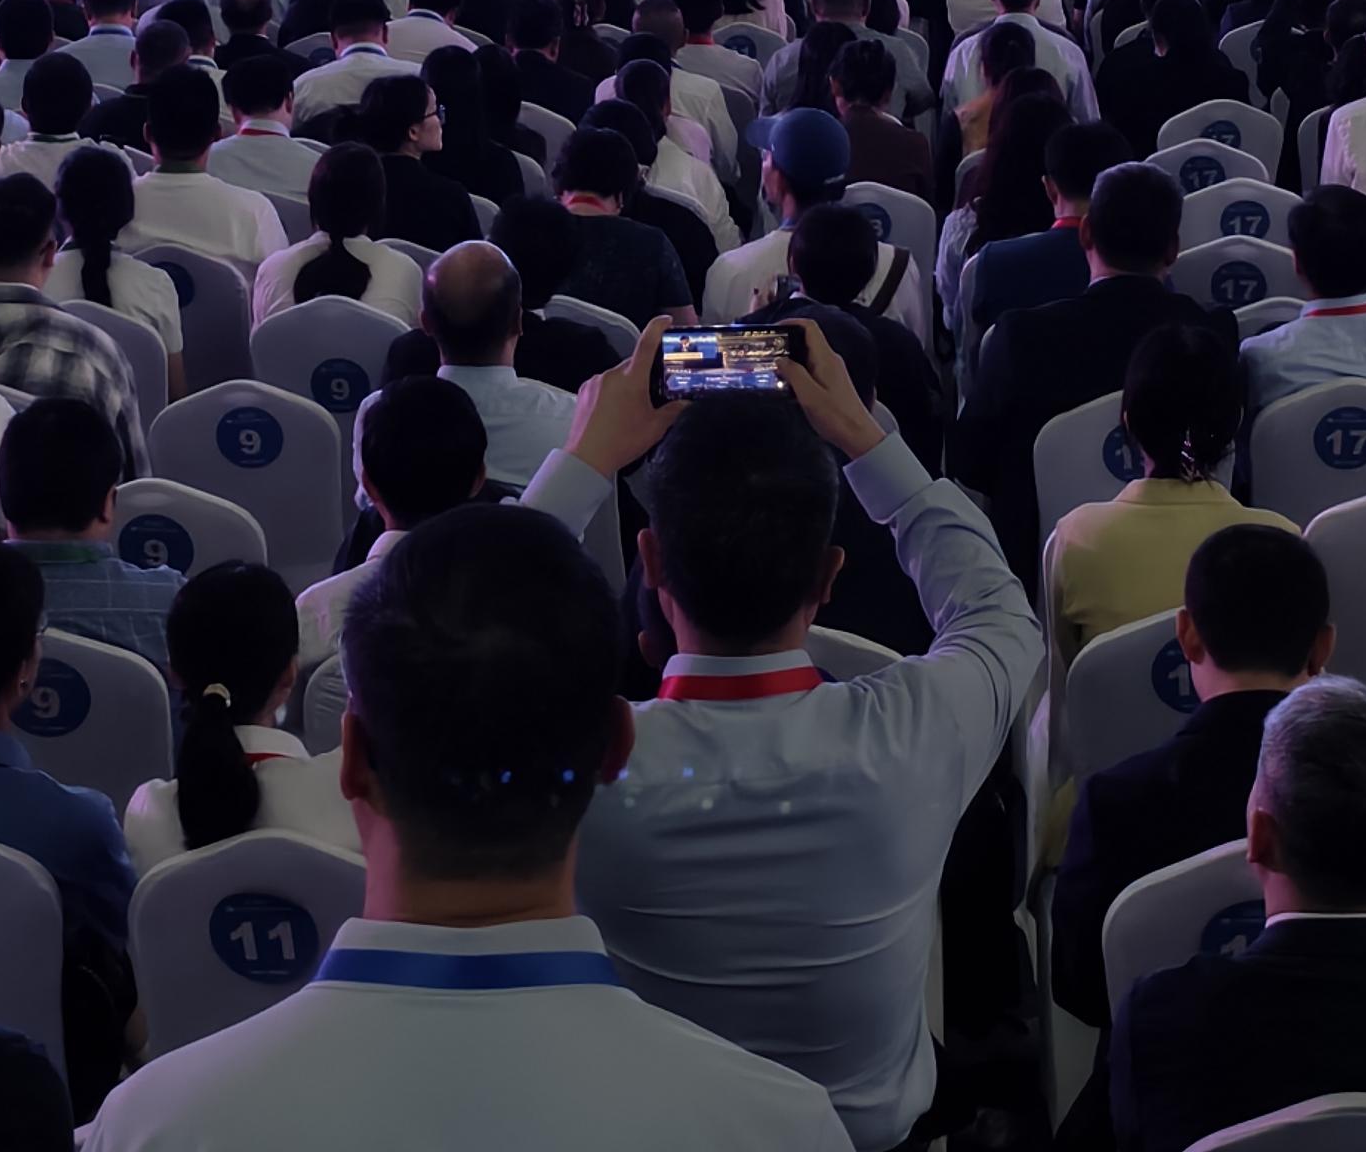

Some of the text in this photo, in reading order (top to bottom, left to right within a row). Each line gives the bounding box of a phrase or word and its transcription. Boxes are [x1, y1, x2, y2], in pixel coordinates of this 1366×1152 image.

[1228, 215, 1263, 236] 17
[1221, 279, 1259, 301] 17
[329, 377, 351, 401] 9
[238, 428, 262, 455] 9
[142, 538, 169, 567] 9
[30, 685, 61, 719] 9
[229, 917, 298, 962] 11
